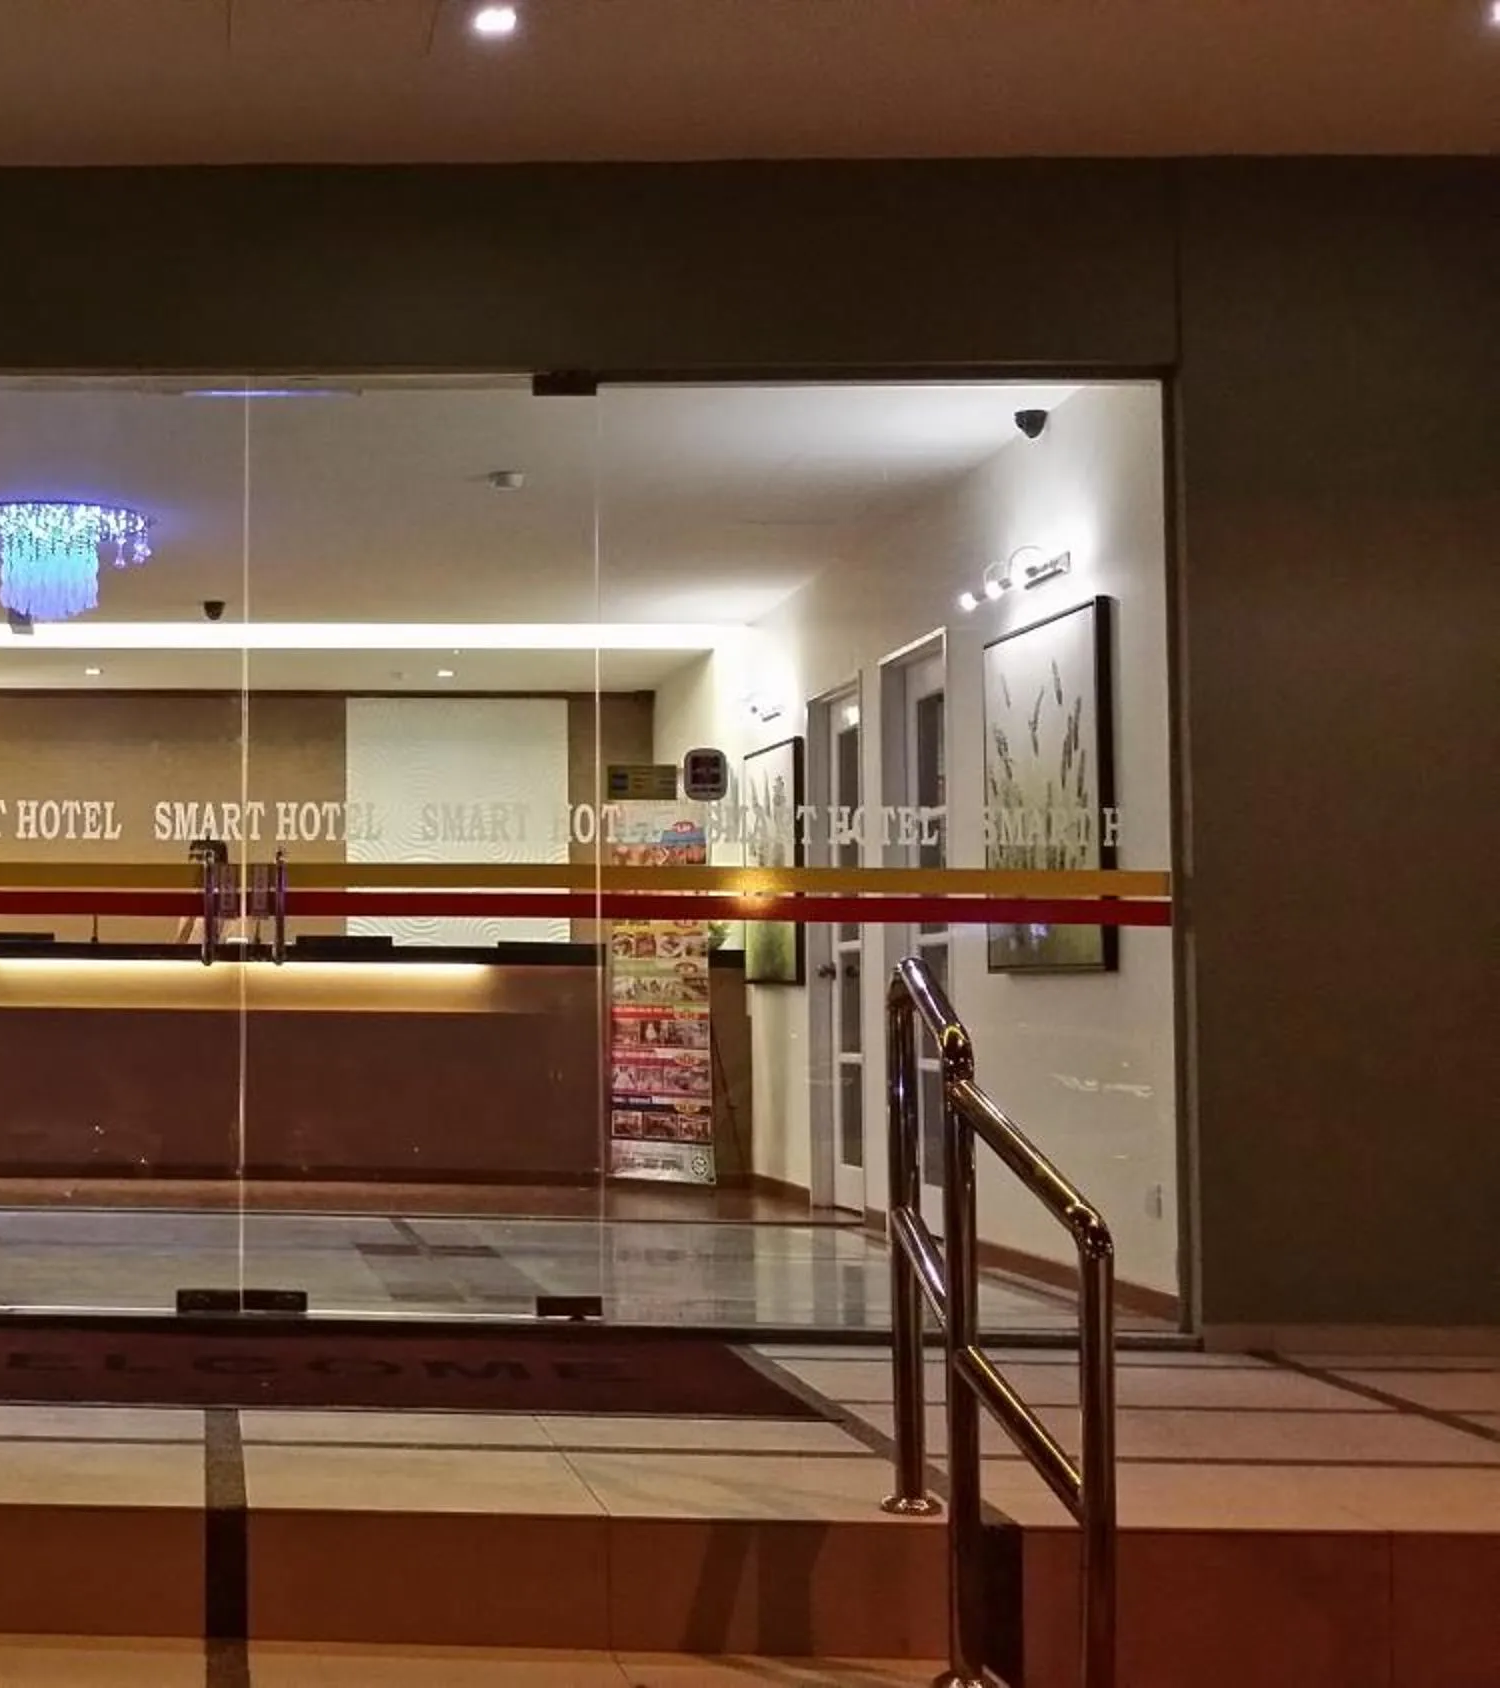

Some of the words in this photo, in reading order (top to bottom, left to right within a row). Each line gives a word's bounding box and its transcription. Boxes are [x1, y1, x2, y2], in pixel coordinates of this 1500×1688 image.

[16, 800, 122, 841] HOTEL
[153, 801, 265, 841] SMART
[275, 802, 381, 842] HOTEL
[420, 803, 530, 843] SMART
[982, 807, 1092, 847] SMART
